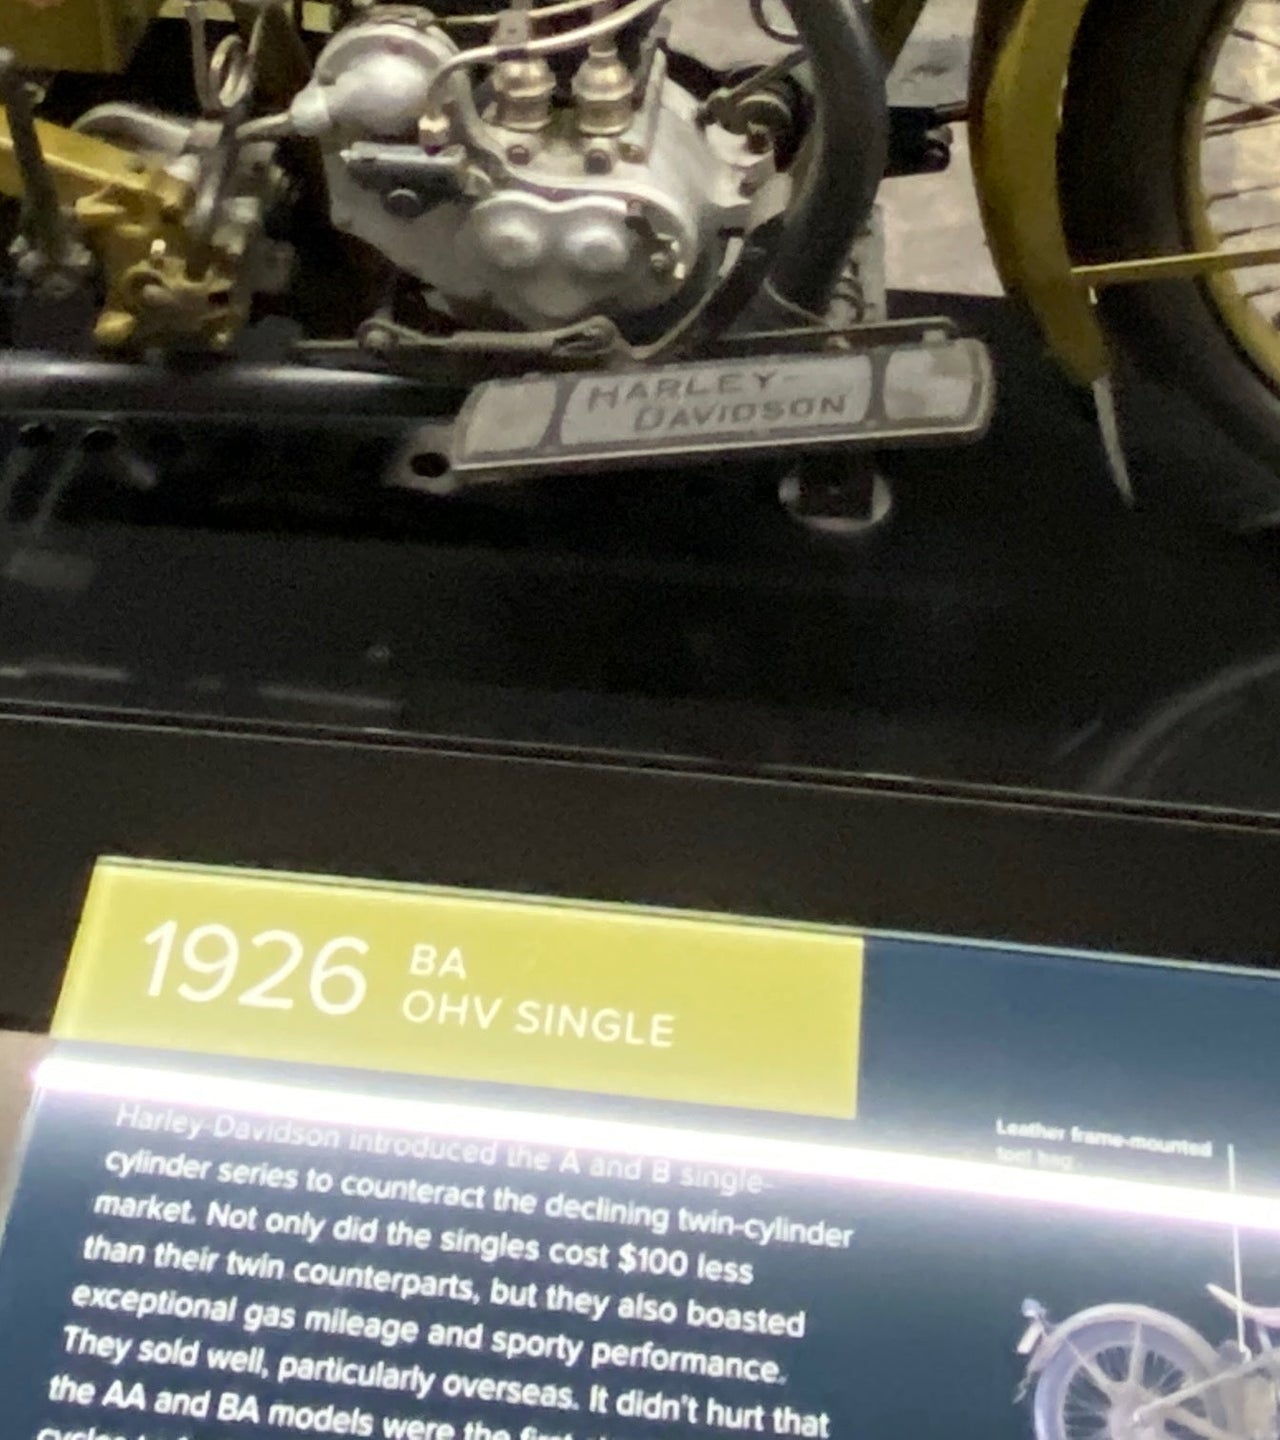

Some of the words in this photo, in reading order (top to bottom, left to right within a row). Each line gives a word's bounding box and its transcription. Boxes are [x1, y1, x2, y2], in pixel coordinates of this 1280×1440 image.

[634, 394, 847, 433] DAVIDSON
[141, 919, 370, 1018] 1926
[407, 943, 467, 980] BA
[401, 990, 499, 1031] OHV
[515, 1000, 676, 1049] SINGLE
[116, 1103, 340, 1148] Harley-Davidson
[349, 1126, 498, 1166] introduced
[506, 1144, 549, 1172] the
[558, 1148, 581, 1175] A
[589, 1156, 642, 1181] and
[651, 1158, 671, 1183] B
[679, 1164, 776, 1197] single-
[995, 1117, 1066, 1142] Leather
[1071, 1125, 1213, 1158] frame-mounted
[93, 1193, 197, 1225] market.
[206, 1201, 258, 1231] Not
[265, 1211, 327, 1244] only
[332, 1215, 379, 1245] did
[386, 1220, 432, 1250] the
[439, 1227, 540, 1263] singles
[548, 1240, 610, 1270] cost
[618, 1242, 688, 1275] $100
[697, 1253, 755, 1286] less
[105, 1148, 211, 1179] cylinder
[216, 1160, 298, 1190] series
[306, 1167, 333, 1193] to
[340, 1174, 485, 1210] counteract
[493, 1188, 538, 1214] the
[545, 1193, 670, 1235] declining
[678, 1207, 855, 1249] twin-cylinder
[82, 1234, 146, 1262] than
[154, 1241, 219, 1274] their
[226, 1253, 285, 1281] twin
[293, 1261, 480, 1305] counterparts,
[489, 1277, 538, 1309] but
[546, 1284, 611, 1322] they
[617, 1292, 678, 1325] also
[686, 1299, 807, 1338] boasted
[71, 1283, 237, 1322] exceptional
[243, 1302, 296, 1332] gas
[304, 1307, 420, 1347] mileage
[427, 1322, 485, 1350] and
[491, 1329, 584, 1367] sporty
[591, 1340, 790, 1386] performance.
[48, 1374, 96, 1405] the
[101, 1379, 147, 1411] AA
[154, 1390, 212, 1418] and
[216, 1392, 261, 1424] BA
[268, 1406, 374, 1438] models
[382, 1417, 456, 1440] were
[63, 1324, 132, 1365] They
[137, 1337, 200, 1367] sold
[206, 1346, 270, 1380] well,
[277, 1355, 437, 1400] particularly
[442, 1373, 580, 1411] overseas.
[588, 1383, 610, 1414] It
[616, 1389, 700, 1424] didn't
[706, 1397, 766, 1431] hurt
[772, 1406, 831, 1439] that
